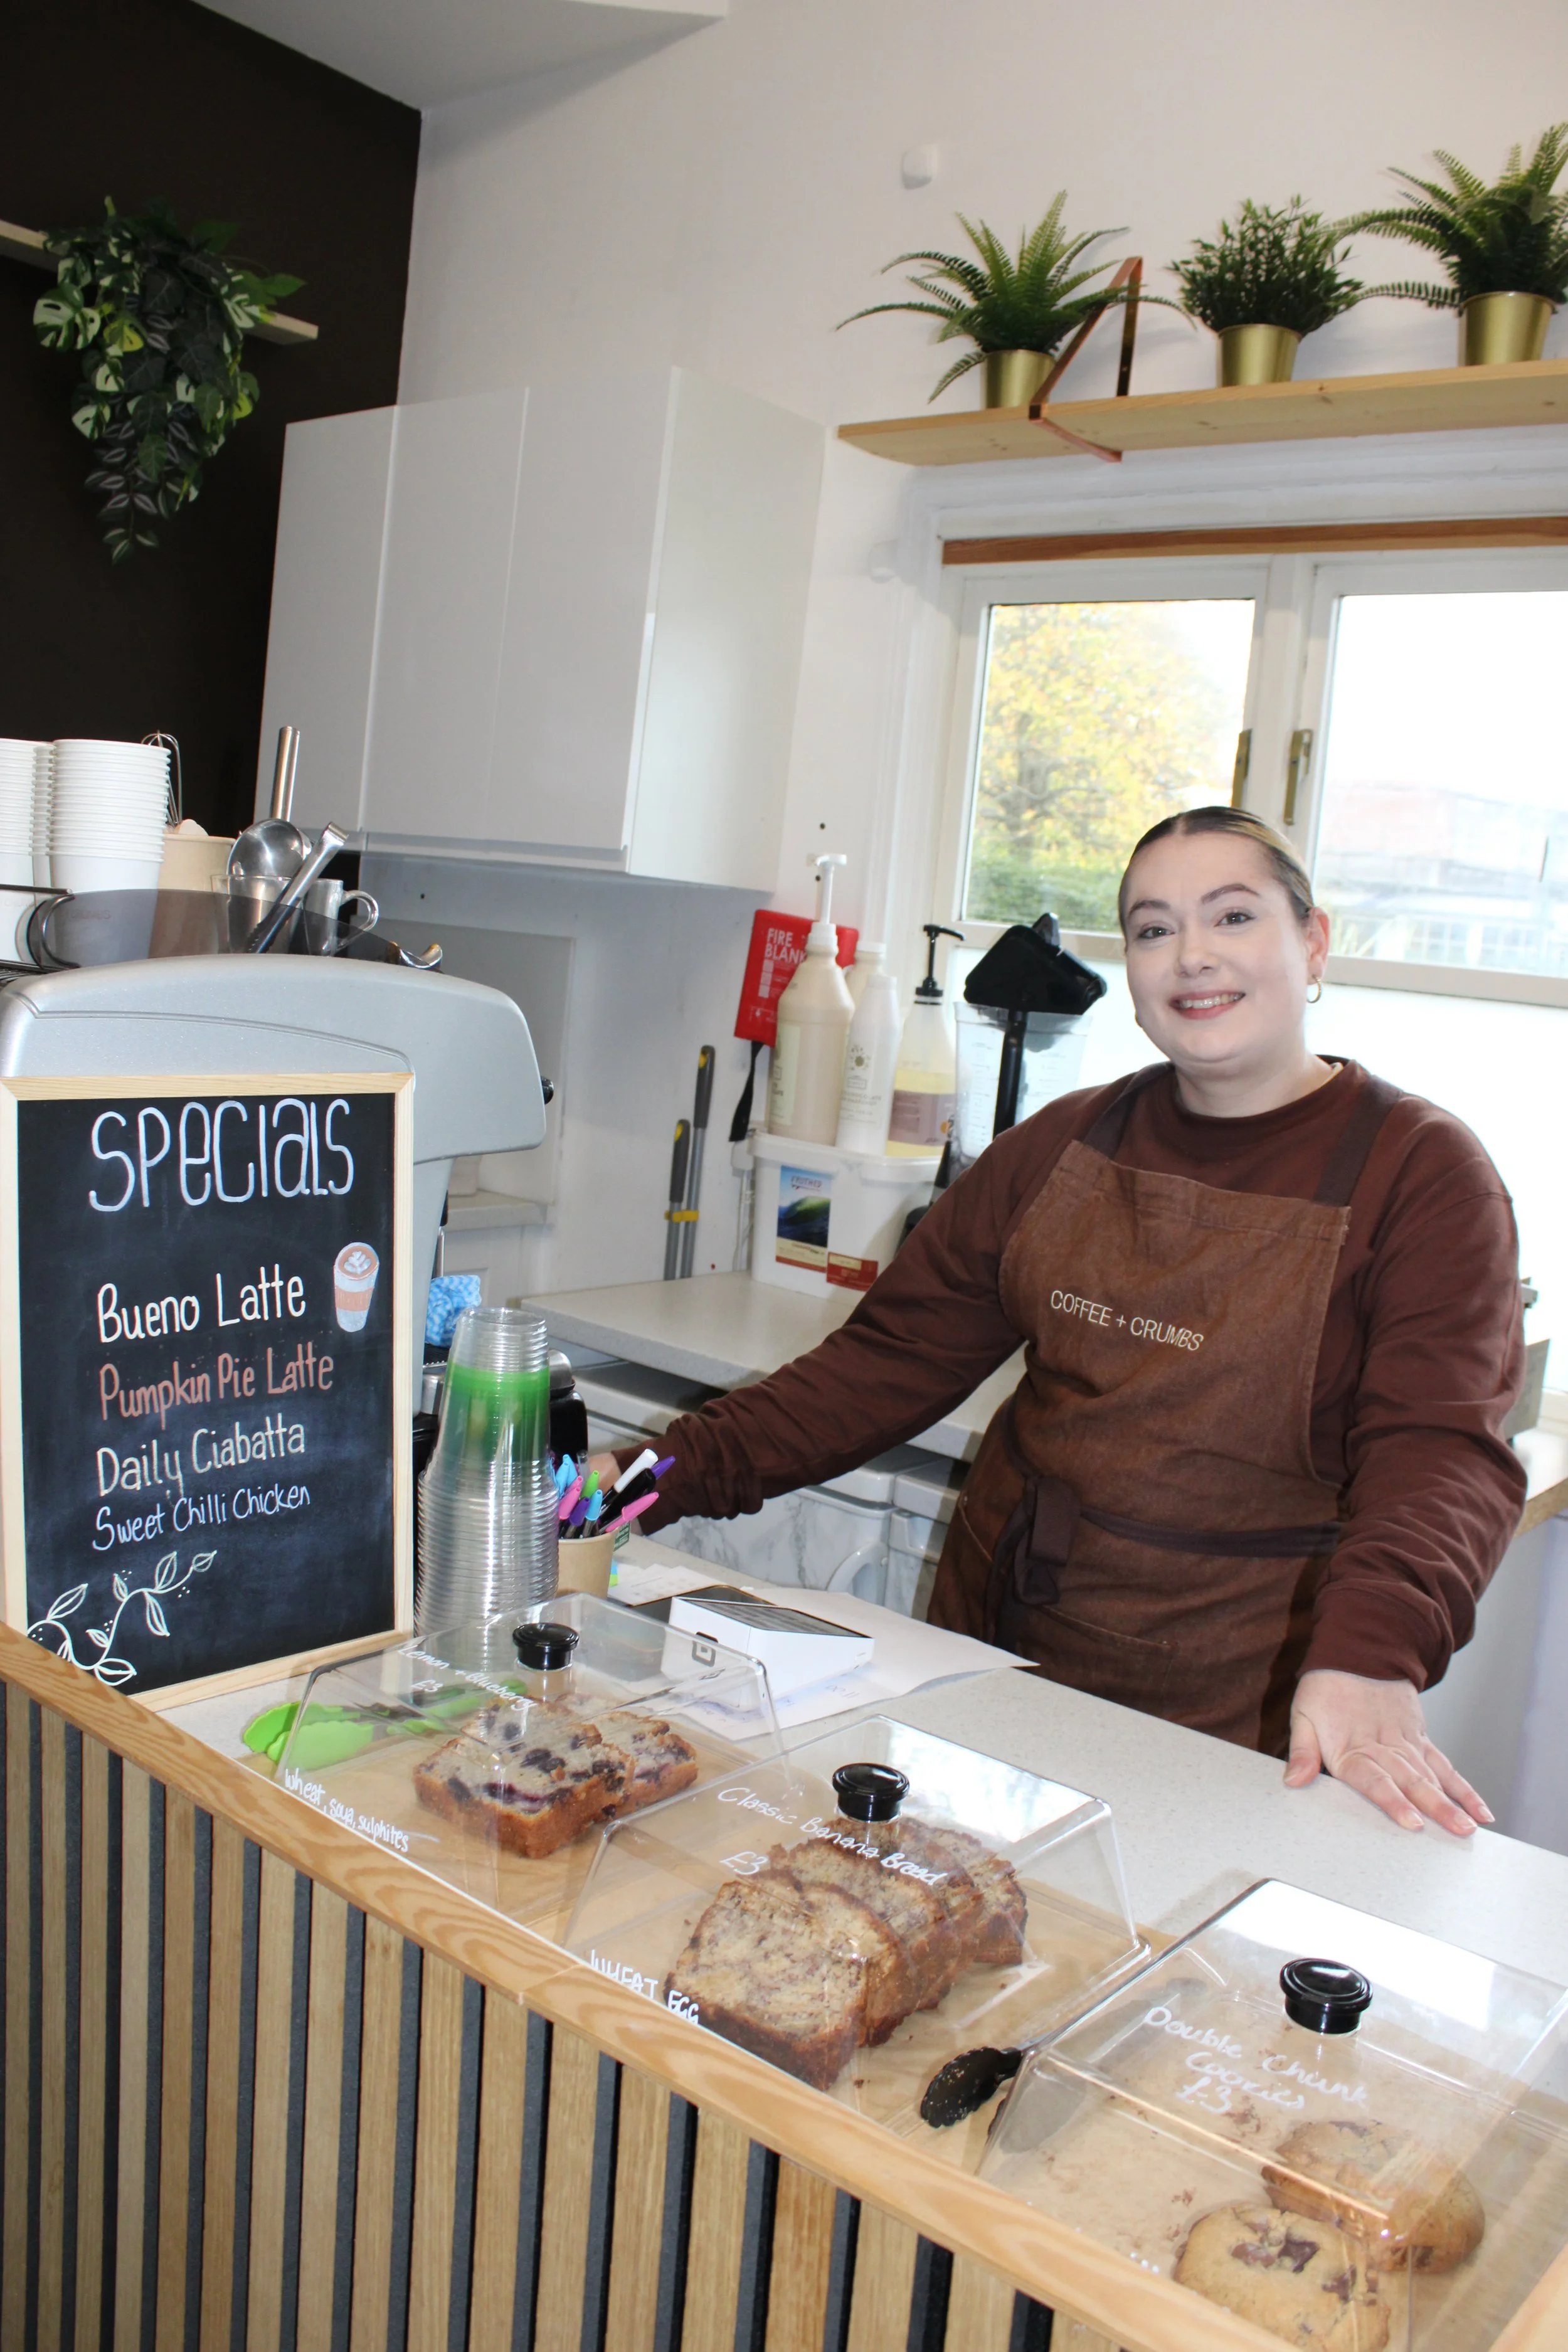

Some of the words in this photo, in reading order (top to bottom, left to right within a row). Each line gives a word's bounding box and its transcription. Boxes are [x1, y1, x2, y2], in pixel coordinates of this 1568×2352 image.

[767, 928, 793, 947] FIRE
[97, 1283, 199, 1343] Bueno
[216, 1264, 305, 1327] Latte
[1051, 1290, 1113, 1327] COFFEE
[1130, 1317, 1204, 1350] CRUMBS
[100, 1361, 211, 1430] Pumpkin
[218, 1353, 255, 1399] Pie
[267, 1342, 334, 1394] Latte
[97, 1439, 184, 1496] Daily
[191, 1412, 305, 1473] Ciabatta
[92, 1506, 166, 1550] Sweet
[173, 1493, 227, 1532] Chilli
[233, 1483, 310, 1520] Chicken
[398, 1645, 450, 1670] Lemon
[465, 1673, 538, 1712] Blueberry
[358, 1814, 409, 1852] sulphites
[717, 1788, 797, 1824] Classic
[799, 1817, 879, 1858] Banana
[881, 1852, 948, 1885] Bread
[591, 1949, 659, 2000] WHEAT
[667, 1989, 699, 2025] EGG
[1143, 2006, 1242, 2059] Double
[1262, 2055, 1369, 2109] Chunk
